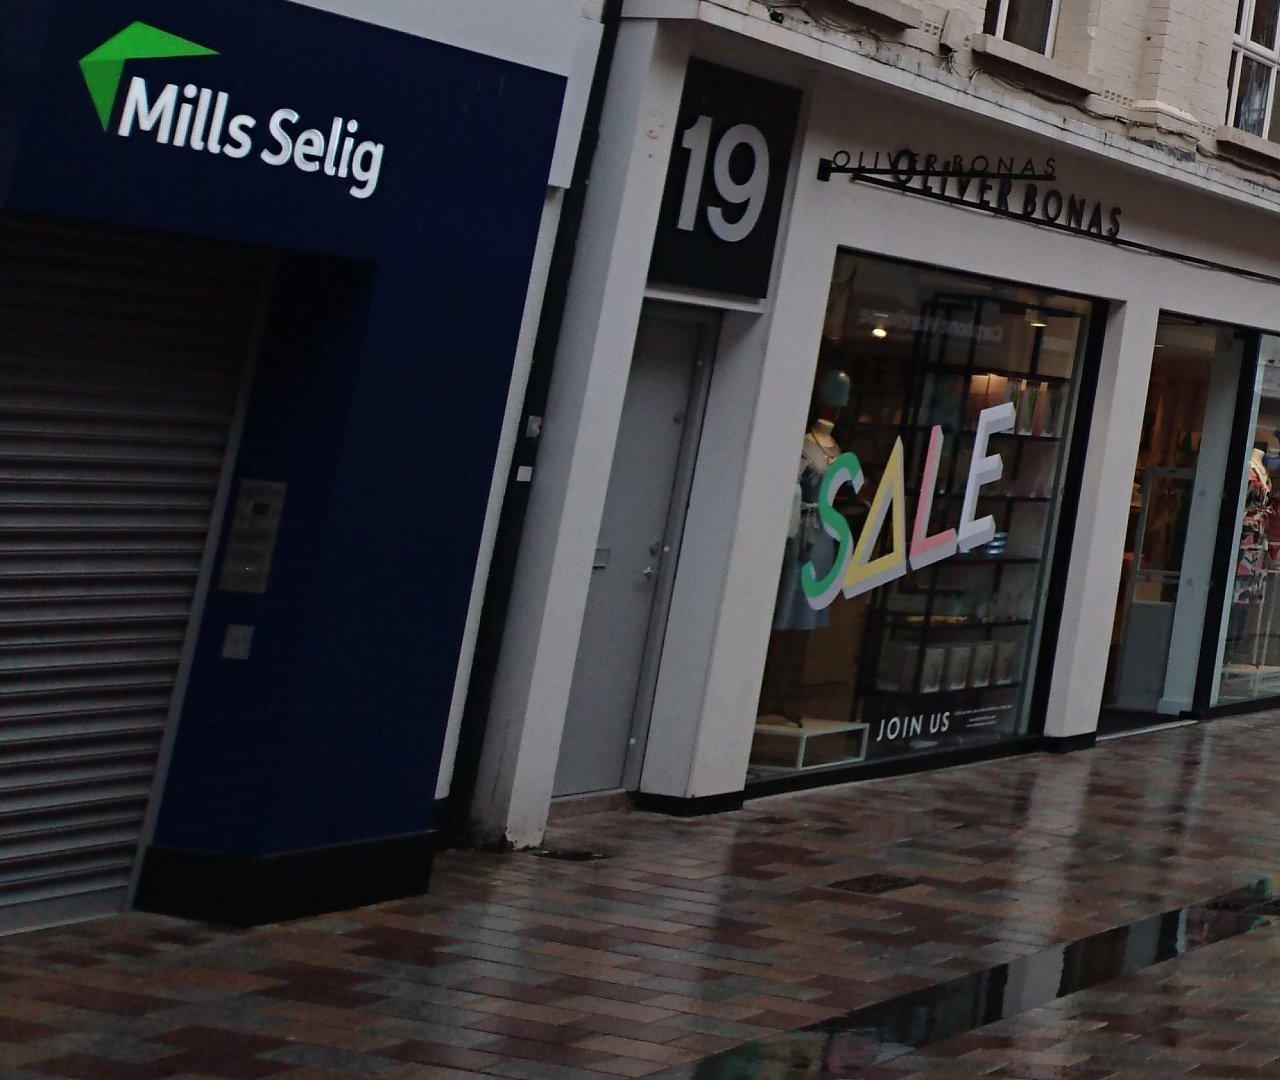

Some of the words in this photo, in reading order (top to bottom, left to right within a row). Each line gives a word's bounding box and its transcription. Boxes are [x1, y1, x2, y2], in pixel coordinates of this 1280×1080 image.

[118, 76, 256, 158] Mills
[260, 108, 384, 199] Selig
[677, 115, 769, 242] 19
[833, 149, 938, 172] OLIVER
[950, 154, 1056, 175] BONAS
[893, 149, 1012, 212] OLIVER
[1022, 183, 1122, 238] BONAS
[802, 402, 1016, 610] SALE
[876, 716, 923, 741] JOIN
[929, 711, 951, 734] US
